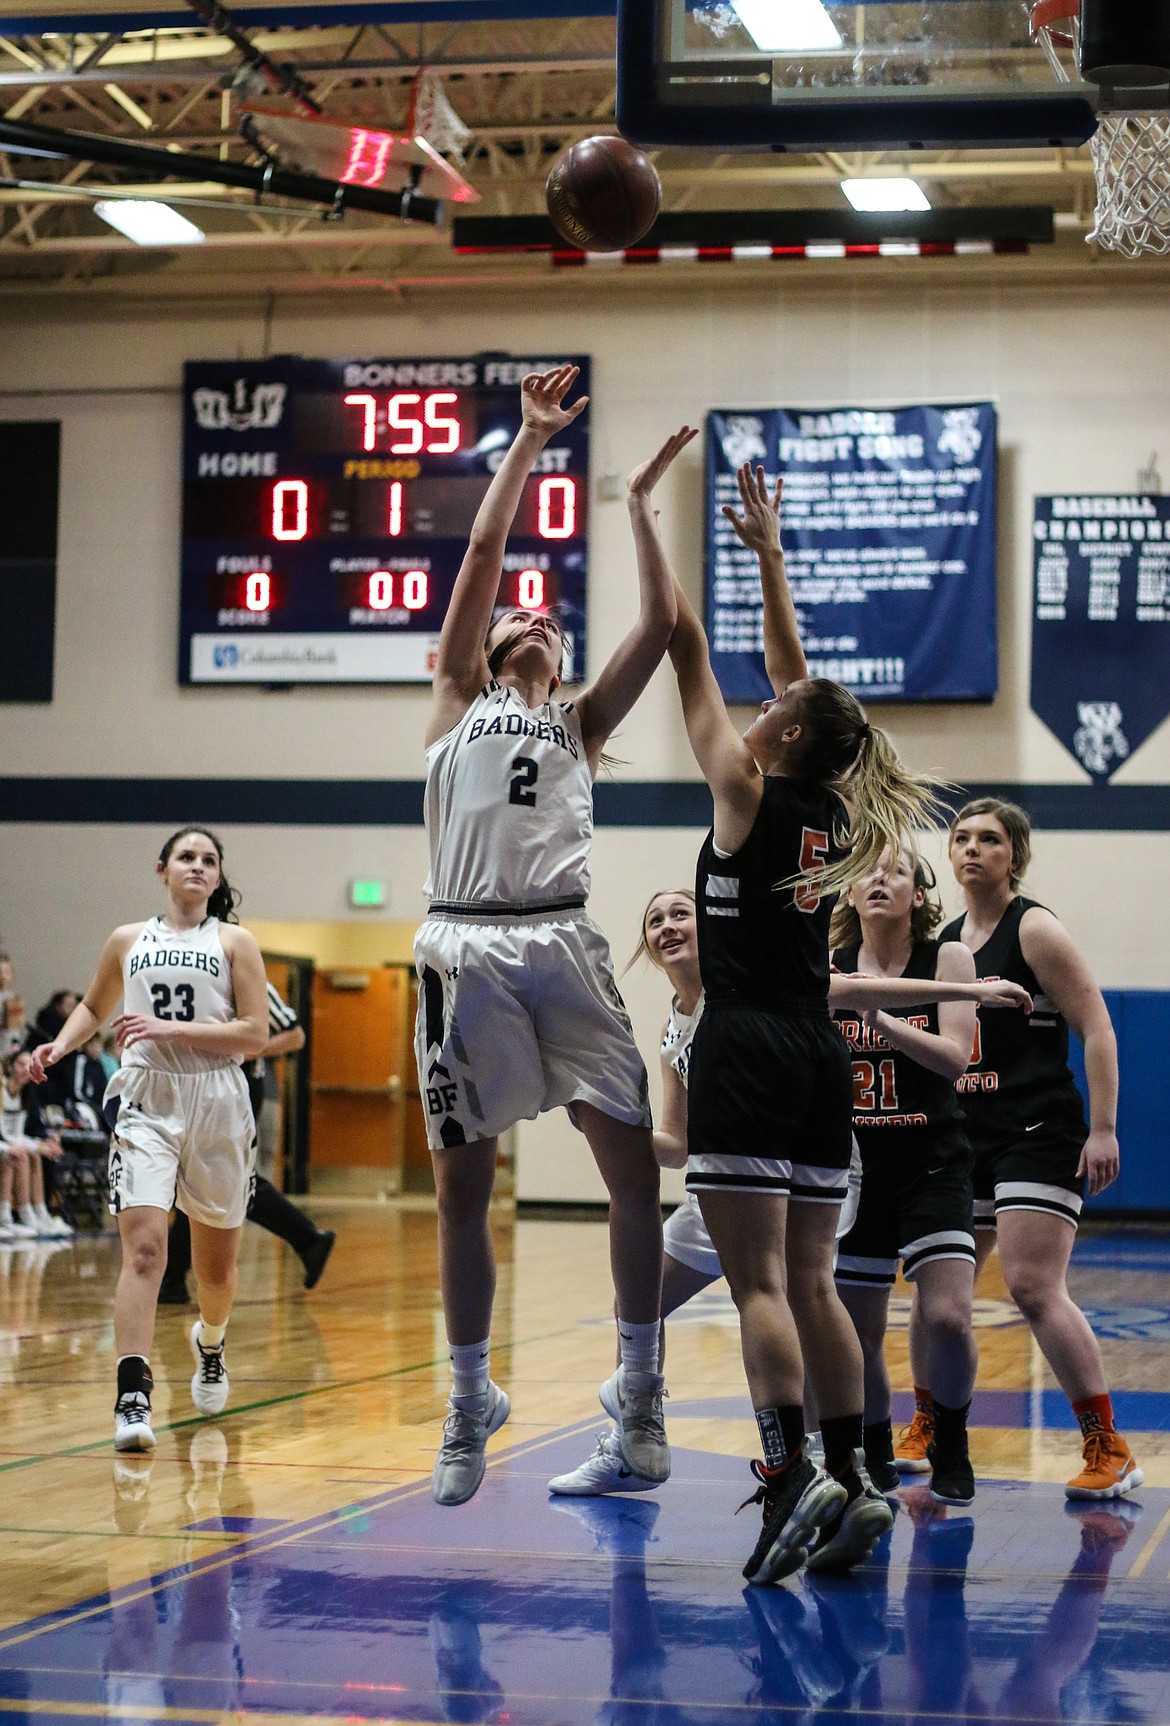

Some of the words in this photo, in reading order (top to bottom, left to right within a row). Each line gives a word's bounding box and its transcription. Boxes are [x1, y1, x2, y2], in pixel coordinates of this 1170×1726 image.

[343, 362, 477, 388] BONNERS
[198, 452, 278, 477] HOME
[343, 459, 421, 479] PERIOD
[271, 480, 308, 541] 0
[389, 481, 403, 537] 1
[537, 477, 576, 539] 0
[246, 572, 270, 611] 0
[518, 569, 544, 609] 0
[508, 756, 539, 807] 2
[794, 826, 829, 915] 5
[130, 949, 220, 978] BADGERS
[151, 983, 196, 1021] 23
[426, 1083, 458, 1115] BF
[852, 1058, 899, 1110] 21
